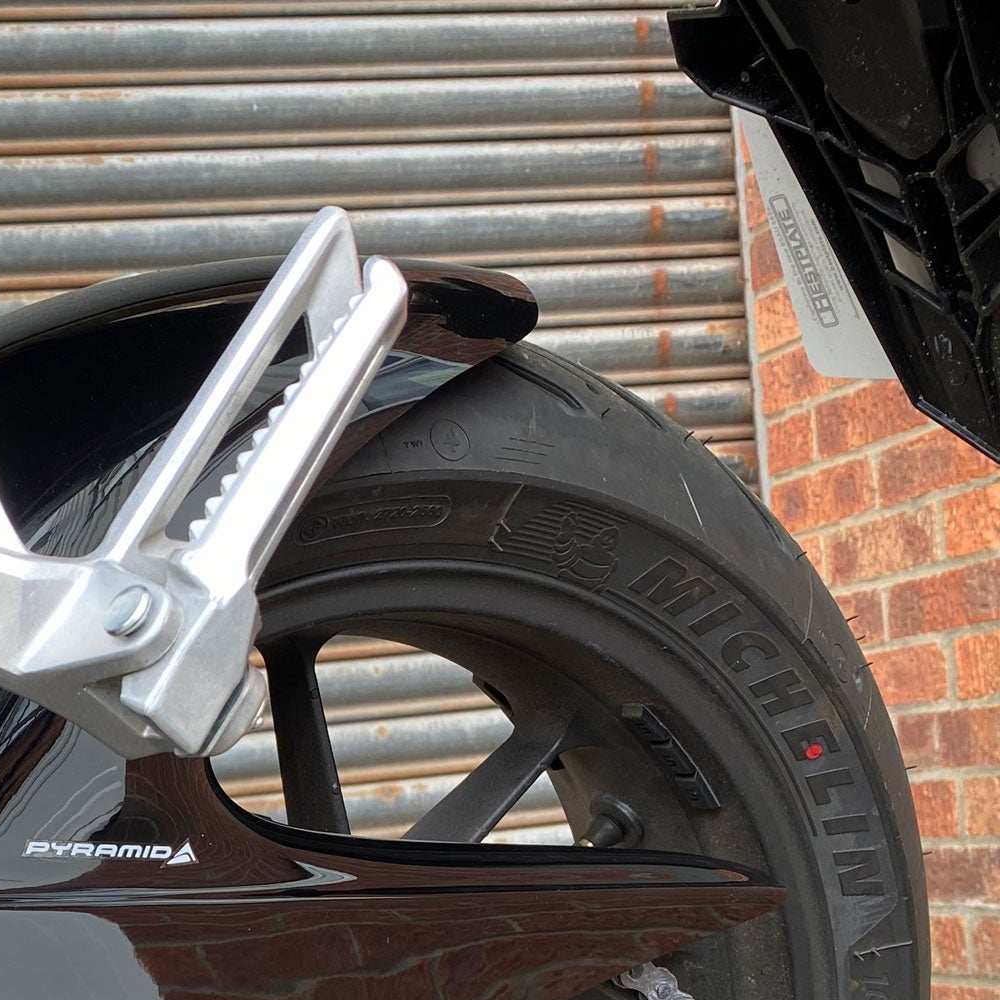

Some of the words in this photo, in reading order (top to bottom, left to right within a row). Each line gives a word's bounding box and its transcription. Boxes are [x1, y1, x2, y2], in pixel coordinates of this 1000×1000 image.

[778, 208, 837, 314] BESTPLATE
[810, 218, 845, 292] www.bestplate.com
[629, 557, 885, 898] MICHELIN
[25, 841, 173, 860] PYRAMID
